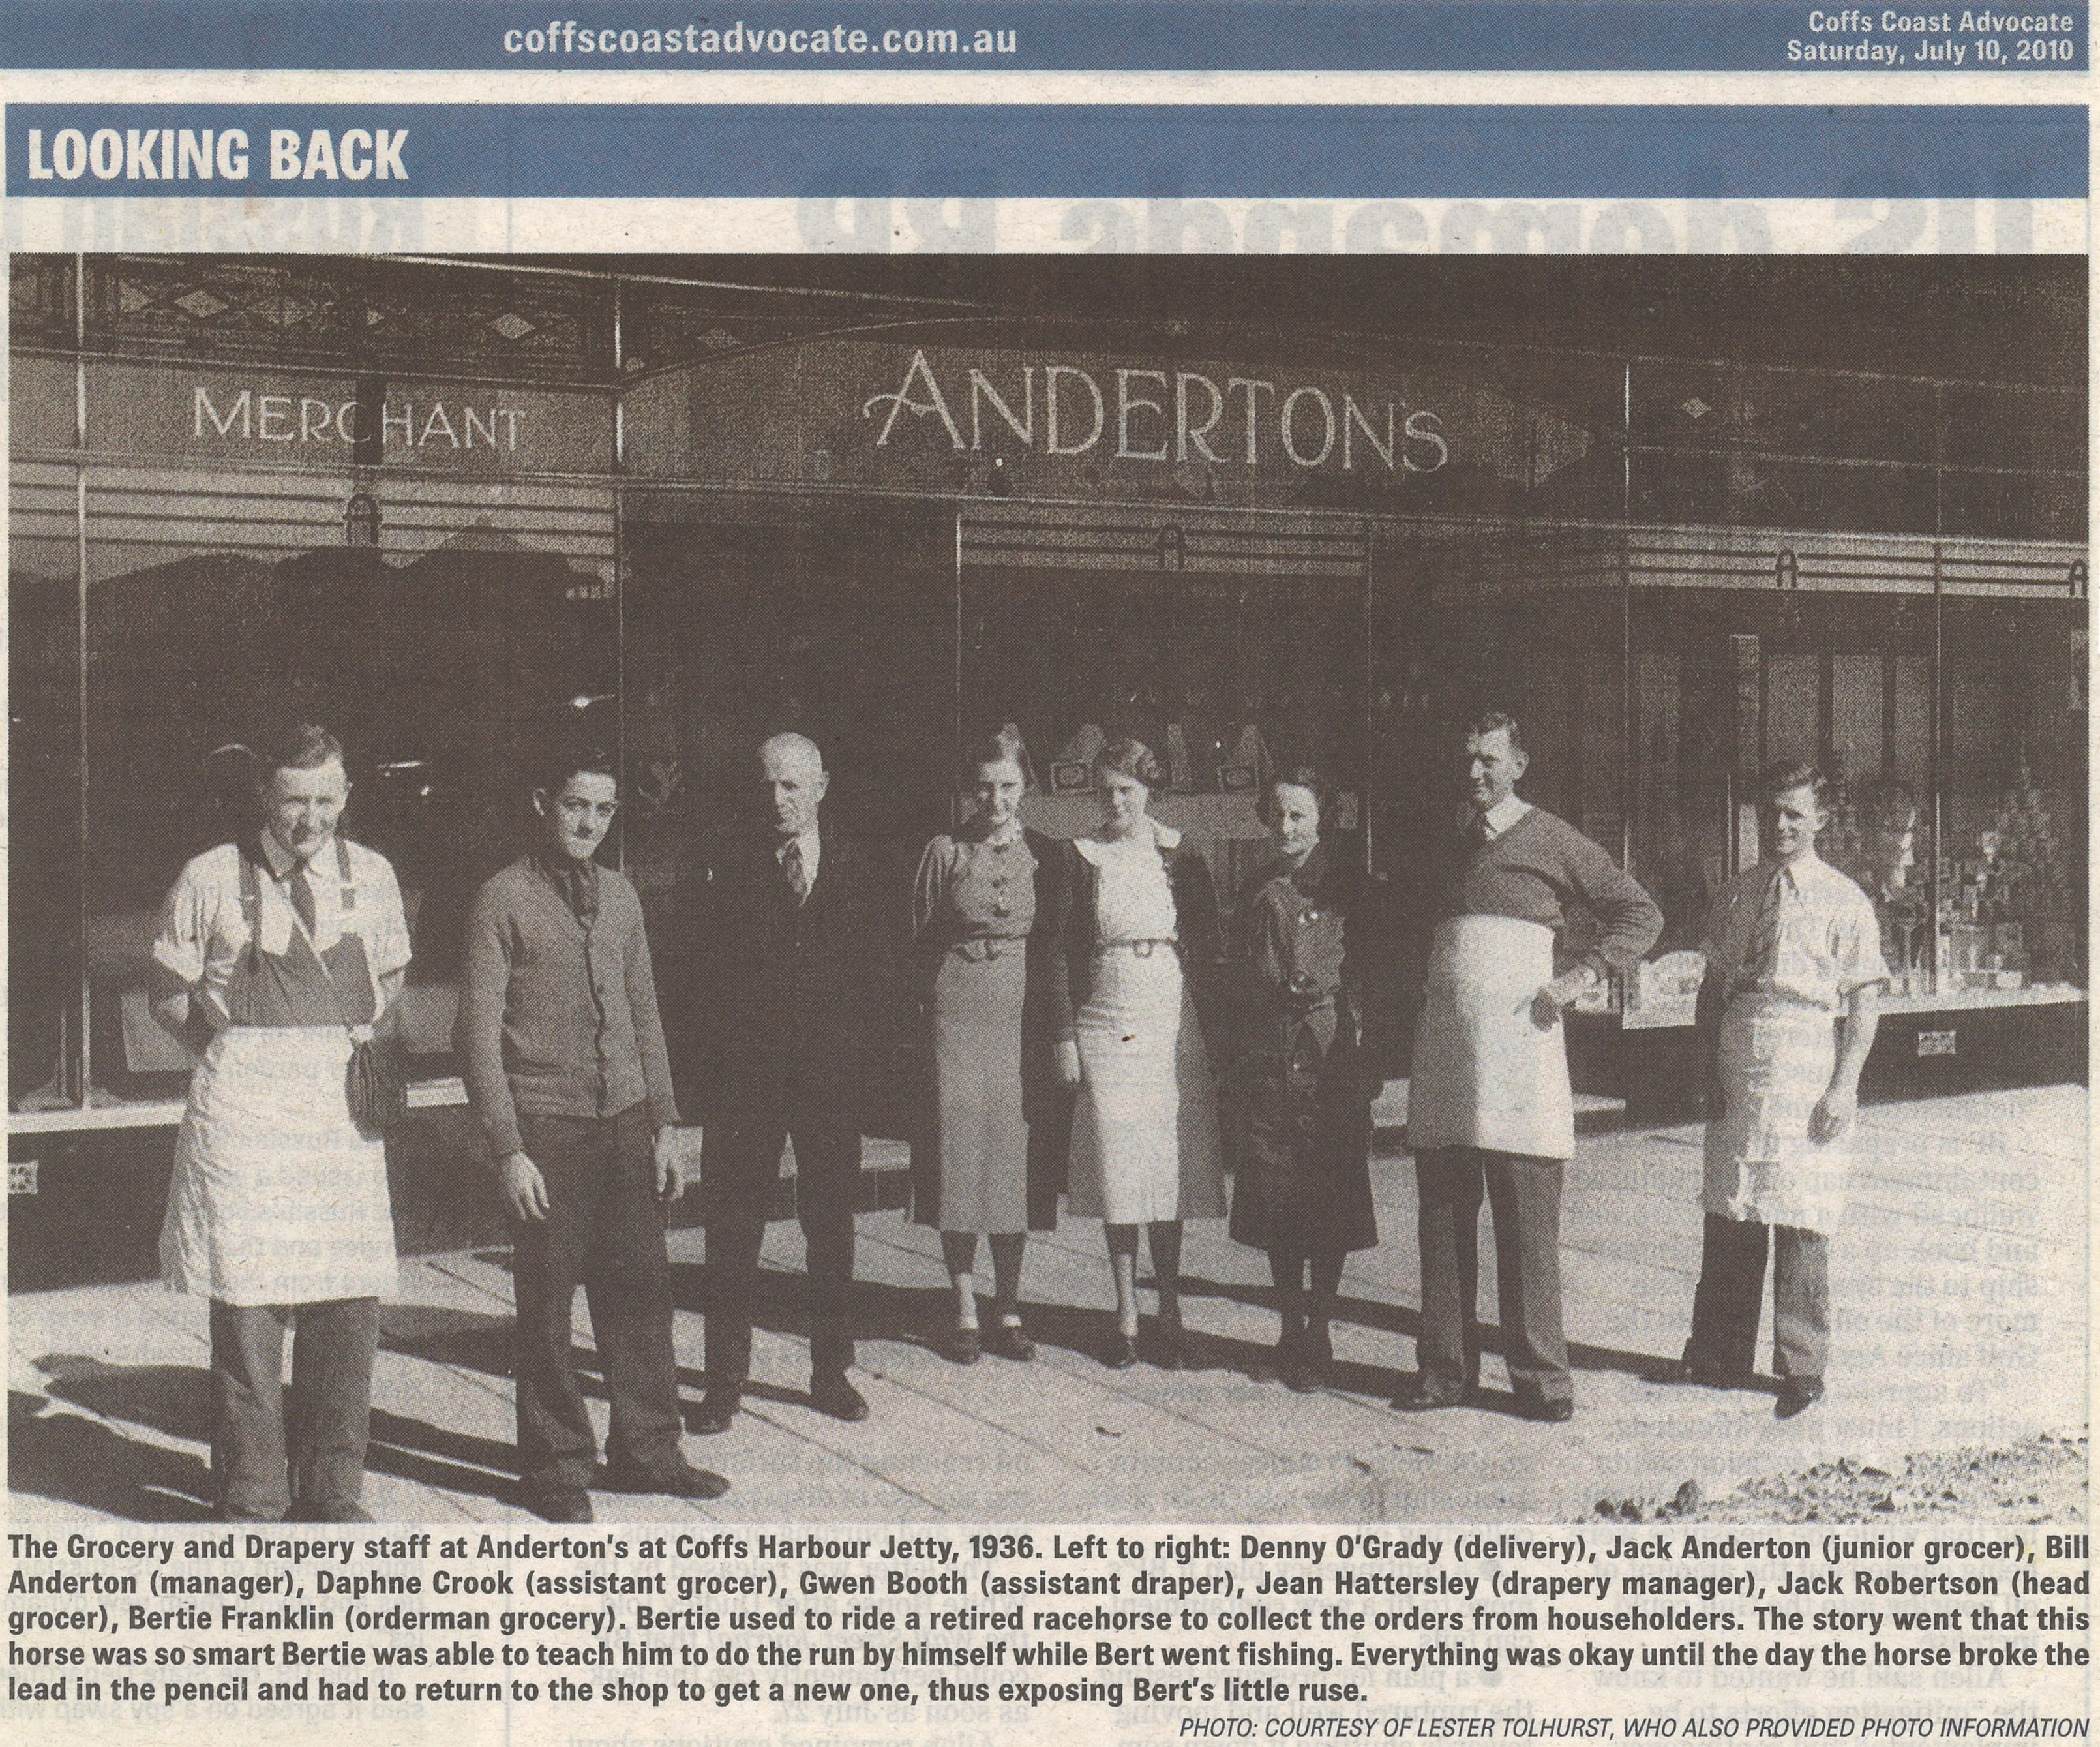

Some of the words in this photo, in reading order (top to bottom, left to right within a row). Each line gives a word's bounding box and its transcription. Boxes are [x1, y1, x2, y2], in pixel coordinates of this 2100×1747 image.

[1809, 10, 1872, 32] Coffs
[1882, 11, 1951, 32] Coast
[1959, 11, 2073, 32] Advocate
[504, 21, 1016, 53] coffscoastadvocate.com.au
[1788, 39, 1904, 65] Saturday,
[1915, 40, 1966, 65] July
[1975, 40, 2007, 65] 10,
[2017, 40, 2073, 61] 2010
[29, 129, 249, 180] LOOKING
[270, 129, 408, 180] BACK
[194, 387, 526, 451] MERCHANT
[8, 1534, 57, 1558] The
[68, 1534, 174, 1564] Grocery
[184, 1534, 234, 1558] and
[245, 1534, 355, 1564] Drapery
[364, 1534, 430, 1558] staff
[440, 1537, 468, 1558] at
[476, 1534, 629, 1559] Anderton's
[638, 1537, 667, 1558] at
[676, 1534, 748, 1559] Coffs
[759, 1534, 871, 1559] Harbour
[880, 1535, 959, 1565] Jetty,
[969, 1534, 1042, 1559] 1936.
[1054, 1534, 1107, 1559] Left
[1117, 1537, 1145, 1559] to
[1155, 1534, 1229, 1565] right:
[1241, 1535, 1327, 1565] Denny
[1336, 1534, 1443, 1565] O'Grady
[1454, 1534, 1596, 1565] (delivery),
[1606, 1534, 1672, 1559] Jack
[1681, 1534, 1810, 1559] Anderton
[1823, 1534, 1914, 1565] (junior
[1924, 1535, 2035, 1565] grocer),
[2046, 1534, 2089, 1559] Bill
[8, 1570, 136, 1594] Anderton
[150, 1570, 304, 1600] (manager),
[317, 1570, 421, 1600] Daphne
[433, 1570, 513, 1594] Crook
[526, 1570, 666, 1597] (assistant
[677, 1570, 787, 1600] grocer),
[800, 1570, 875, 1594] Gwen
[888, 1570, 967, 1594] Booth
[981, 1570, 1120, 1598] (assistant
[1132, 1570, 1244, 1600] draper),
[1256, 1571, 1323, 1594] Jean
[1336, 1570, 1479, 1601] Hattersley
[1492, 1570, 1611, 1600] (drapery
[1622, 1570, 1765, 1601] manager),
[1778, 1570, 1844, 1595] Jack
[1855, 1570, 1998, 1595] Robertson
[2012, 1570, 2090, 1598] (head
[8, 1605, 118, 1635] grocer),
[129, 1605, 212, 1630] Bertie
[222, 1605, 333, 1630] Franklin
[346, 1605, 490, 1633] (orderman
[500, 1605, 626, 1636] grocery).
[637, 1605, 720, 1630] Bertie
[730, 1605, 794, 1630] used
[804, 1608, 832, 1630] to
[842, 1605, 895, 1630] ride
[905, 1612, 920, 1630] a
[930, 1605, 1023, 1630] retired
[1034, 1605, 1171, 1630] racehorse
[1180, 1608, 1208, 1630] to
[1218, 1605, 1312, 1630] collect
[1320, 1605, 1365, 1630] the
[1375, 1605, 1463, 1630] orders
[1472, 1605, 1537, 1630] from
[1548, 1605, 1744, 1630] householders.
[1753, 1605, 1803, 1630] The
[1813, 1609, 1884, 1636] story
[1892, 1609, 1962, 1630] went
[1970, 1606, 2028, 1630] that
[2036, 1606, 2090, 1630] this
[9, 1641, 85, 1665] horse
[92, 1647, 147, 1665] was
[155, 1647, 185, 1665] so
[192, 1644, 275, 1665] smart
[282, 1641, 366, 1665] Bertie
[372, 1647, 428, 1665] was
[436, 1641, 494, 1665] able
[502, 1644, 529, 1666] to
[536, 1641, 614, 1665] teach
[623, 1641, 672, 1665] him
[680, 1644, 708, 1666] to
[716, 1641, 749, 1666] do
[757, 1641, 802, 1666] the
[809, 1648, 854, 1665] run
[863, 1641, 895, 1672] by
[903, 1641, 1006, 1666] himself
[1013, 1641, 1087, 1666] while
[1096, 1642, 1154, 1666] Bert
[1161, 1644, 1230, 1666] went
[1237, 1641, 1342, 1672] fishing.
[1351, 1641, 1498, 1672] Everything
[1506, 1648, 1561, 1666] was
[1568, 1641, 1634, 1672] okay
[1642, 1641, 1704, 1666] until
[1712, 1642, 1758, 1666] the
[1765, 1641, 1814, 1672] day
[1821, 1642, 1867, 1666] the
[1874, 1641, 1951, 1666] horse
[1959, 1641, 2037, 1666] broke
[2045, 1641, 2090, 1666] the
[9, 1677, 67, 1701] lead
[76, 1677, 100, 1701] in
[110, 1677, 155, 1701] the
[165, 1677, 248, 1707] pencil
[258, 1677, 308, 1701] and
[318, 1677, 368, 1701] had
[378, 1679, 406, 1701] to
[416, 1679, 502, 1701] return
[511, 1680, 539, 1701] to
[548, 1677, 593, 1701] the
[602, 1677, 668, 1707] shop
[677, 1680, 705, 1701] to
[715, 1680, 760, 1707] get
[769, 1683, 784, 1701] a
[794, 1683, 851, 1701] new
[860, 1683, 918, 1706] one,
[928, 1677, 989, 1701] thus
[998, 1677, 1123, 1707] exposing
[1133, 1677, 1214, 1701] Bert's
[1224, 1677, 1289, 1701] little
[1299, 1683, 1367, 1701] ruse.
[1180, 1718, 1258, 1737] PHOTO:
[1265, 1718, 1379, 1737] COURTESY
[1383, 1718, 1413, 1737] OF
[1417, 1718, 1495, 1737] LESTER
[1503, 1718, 1614, 1740] TOLHURST,
[1624, 1718, 1677, 1737] WHO
[1682, 1718, 1739, 1737] ALSO
[1745, 1718, 1855, 1738] PROVIDED
[1861, 1718, 1934, 1737] PHOTO
[1940, 1718, 2090, 1737] INFORMATION
